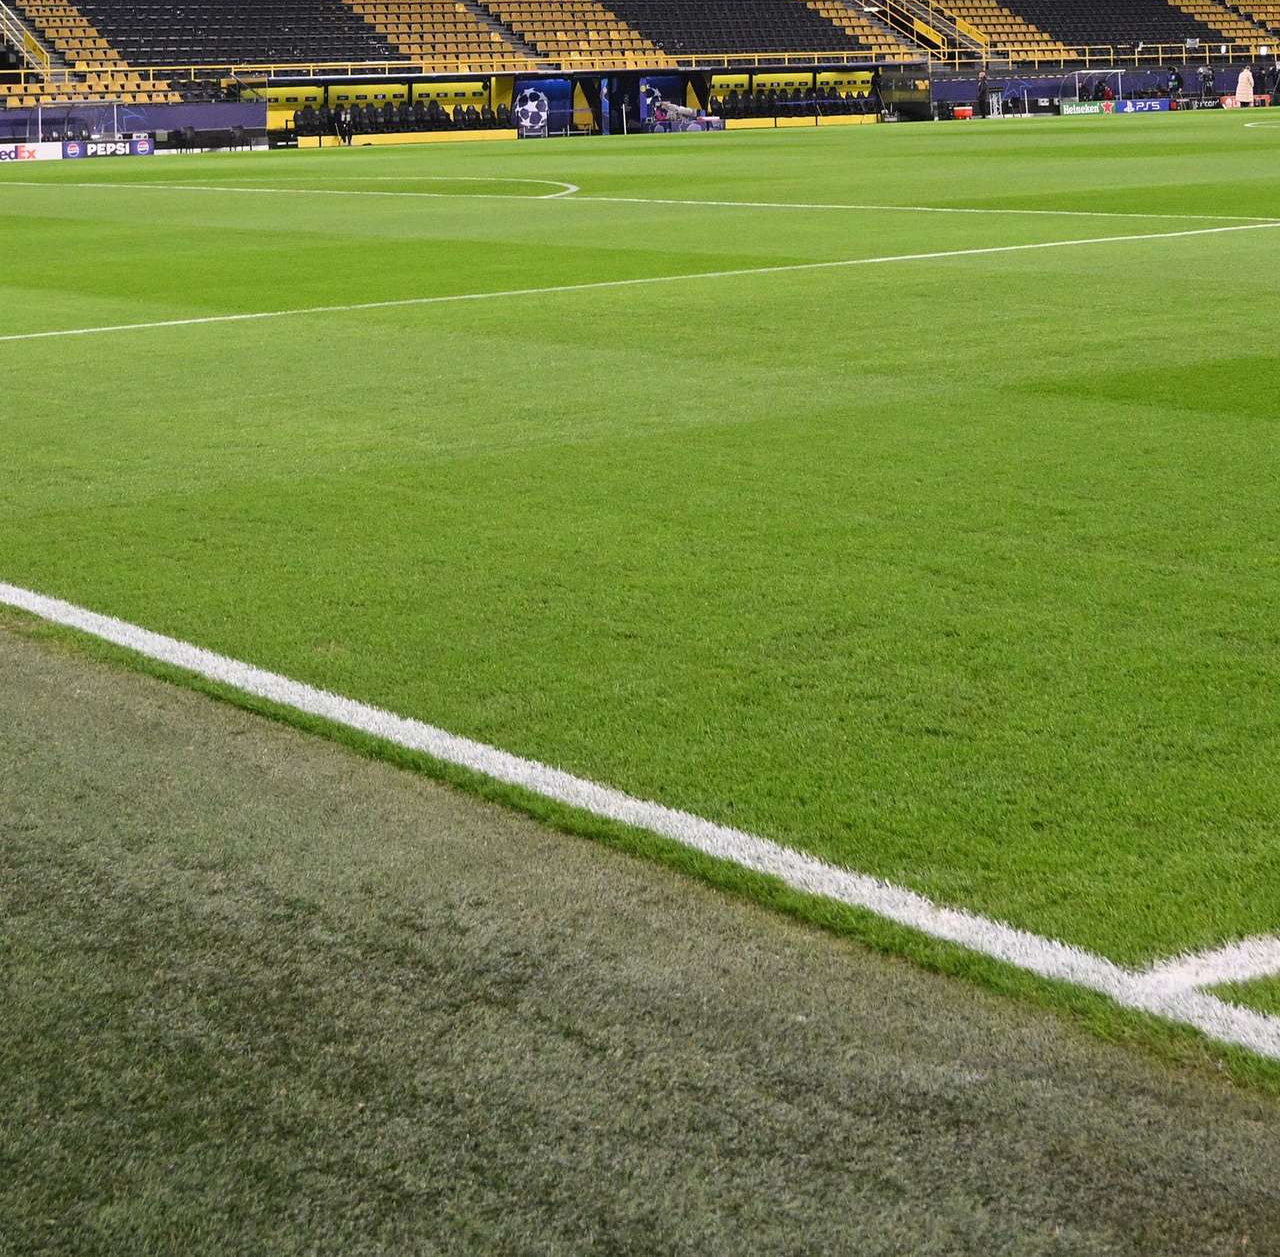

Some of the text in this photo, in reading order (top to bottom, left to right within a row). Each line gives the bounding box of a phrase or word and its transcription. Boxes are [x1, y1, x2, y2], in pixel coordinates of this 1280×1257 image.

[1062, 102, 1100, 115] Heineken
[1135, 101, 1160, 111] PS5
[86, 143, 130, 156] PEPSI
